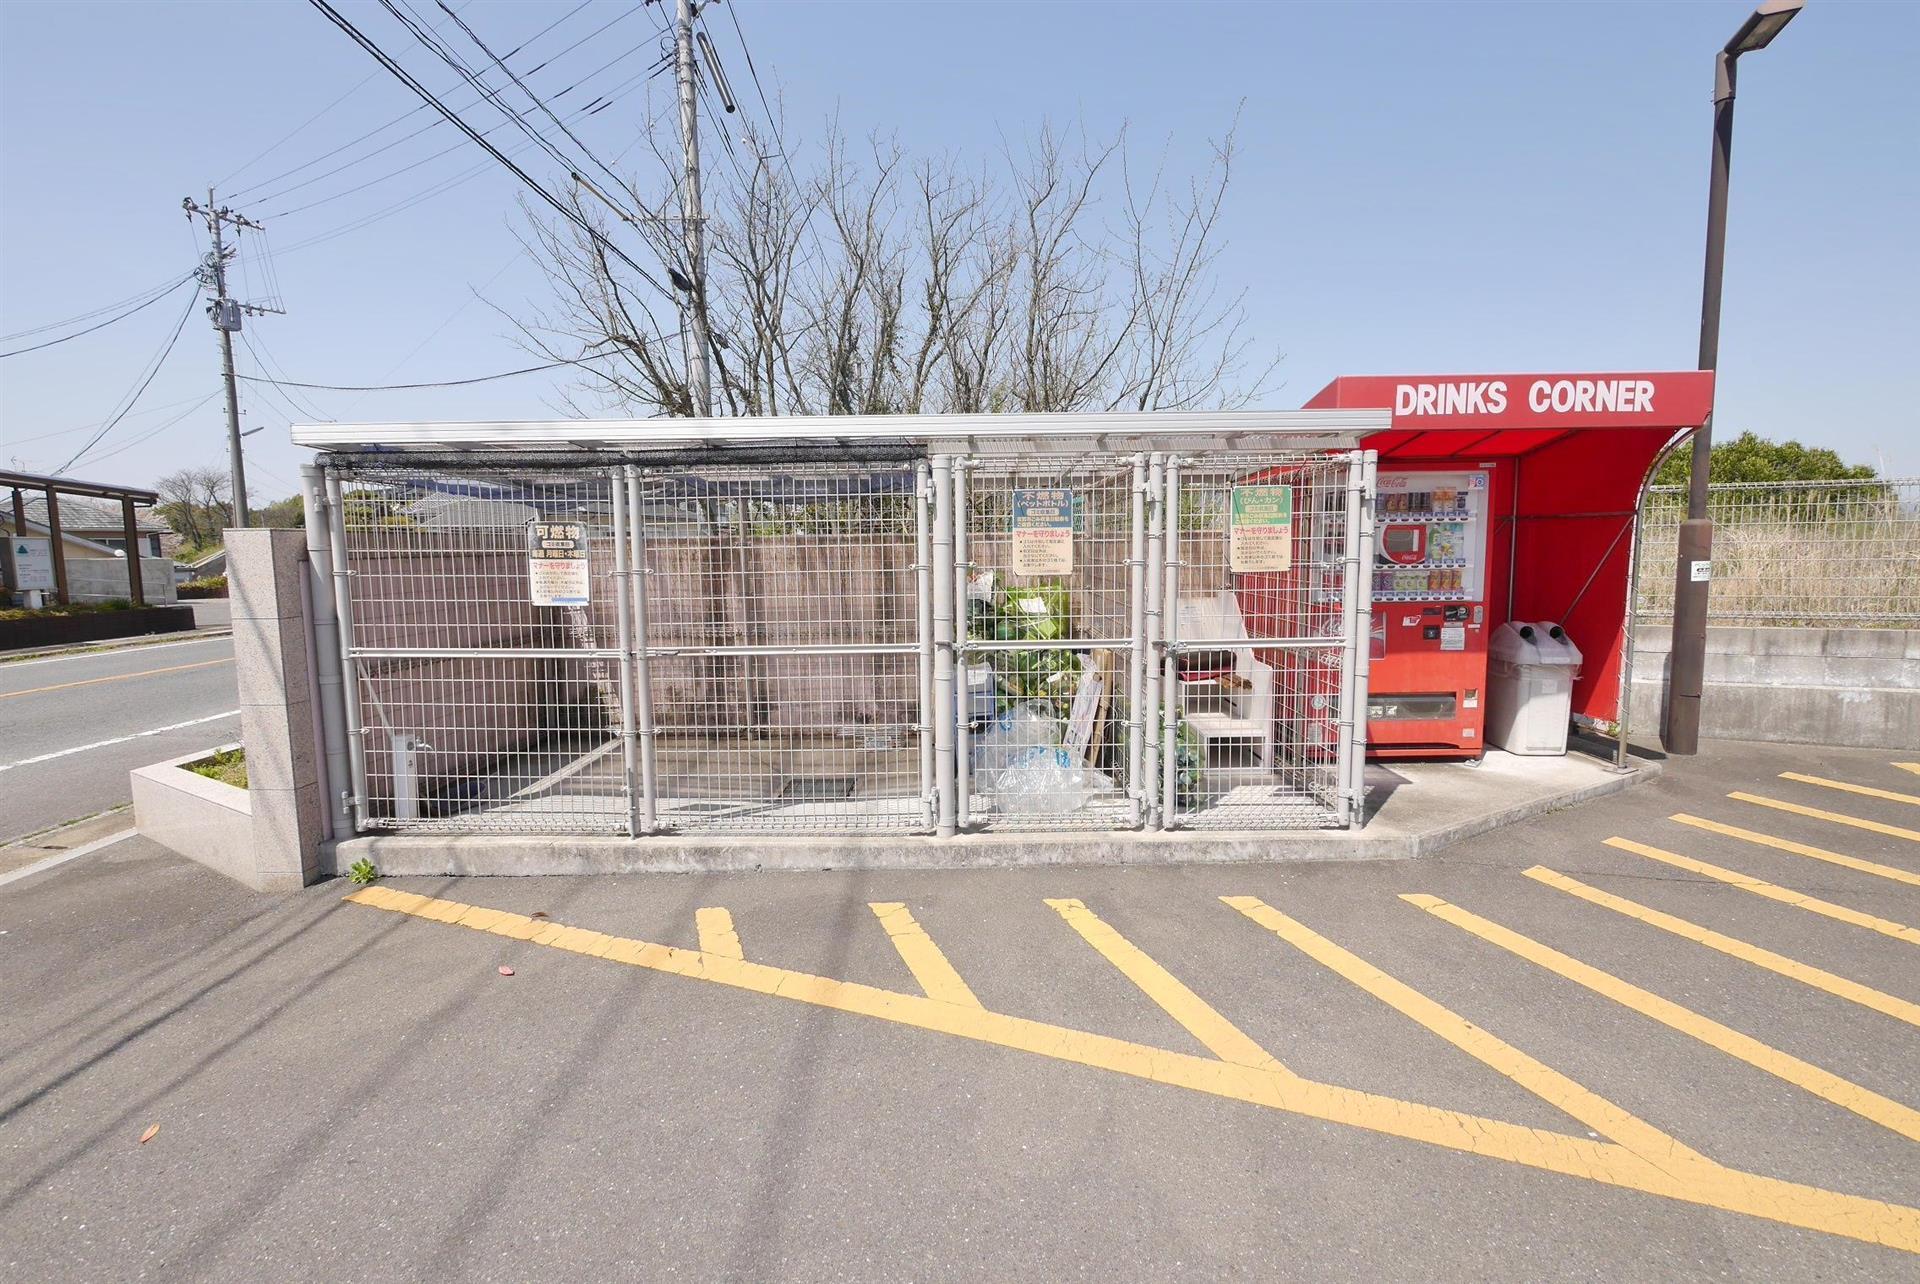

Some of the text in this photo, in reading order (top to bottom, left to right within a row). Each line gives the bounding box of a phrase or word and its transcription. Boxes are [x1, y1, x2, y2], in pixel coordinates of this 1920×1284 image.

[1395, 380, 1655, 416] DRINKS CORNER
[1022, 491, 1064, 500] 不燃物
[535, 525, 580, 539] 可燃物
[1015, 530, 1071, 538] マナーを守りましょう
[1233, 527, 1289, 535] マナーを守りましょう
[533, 562, 586, 570] マナーを守りましょう
